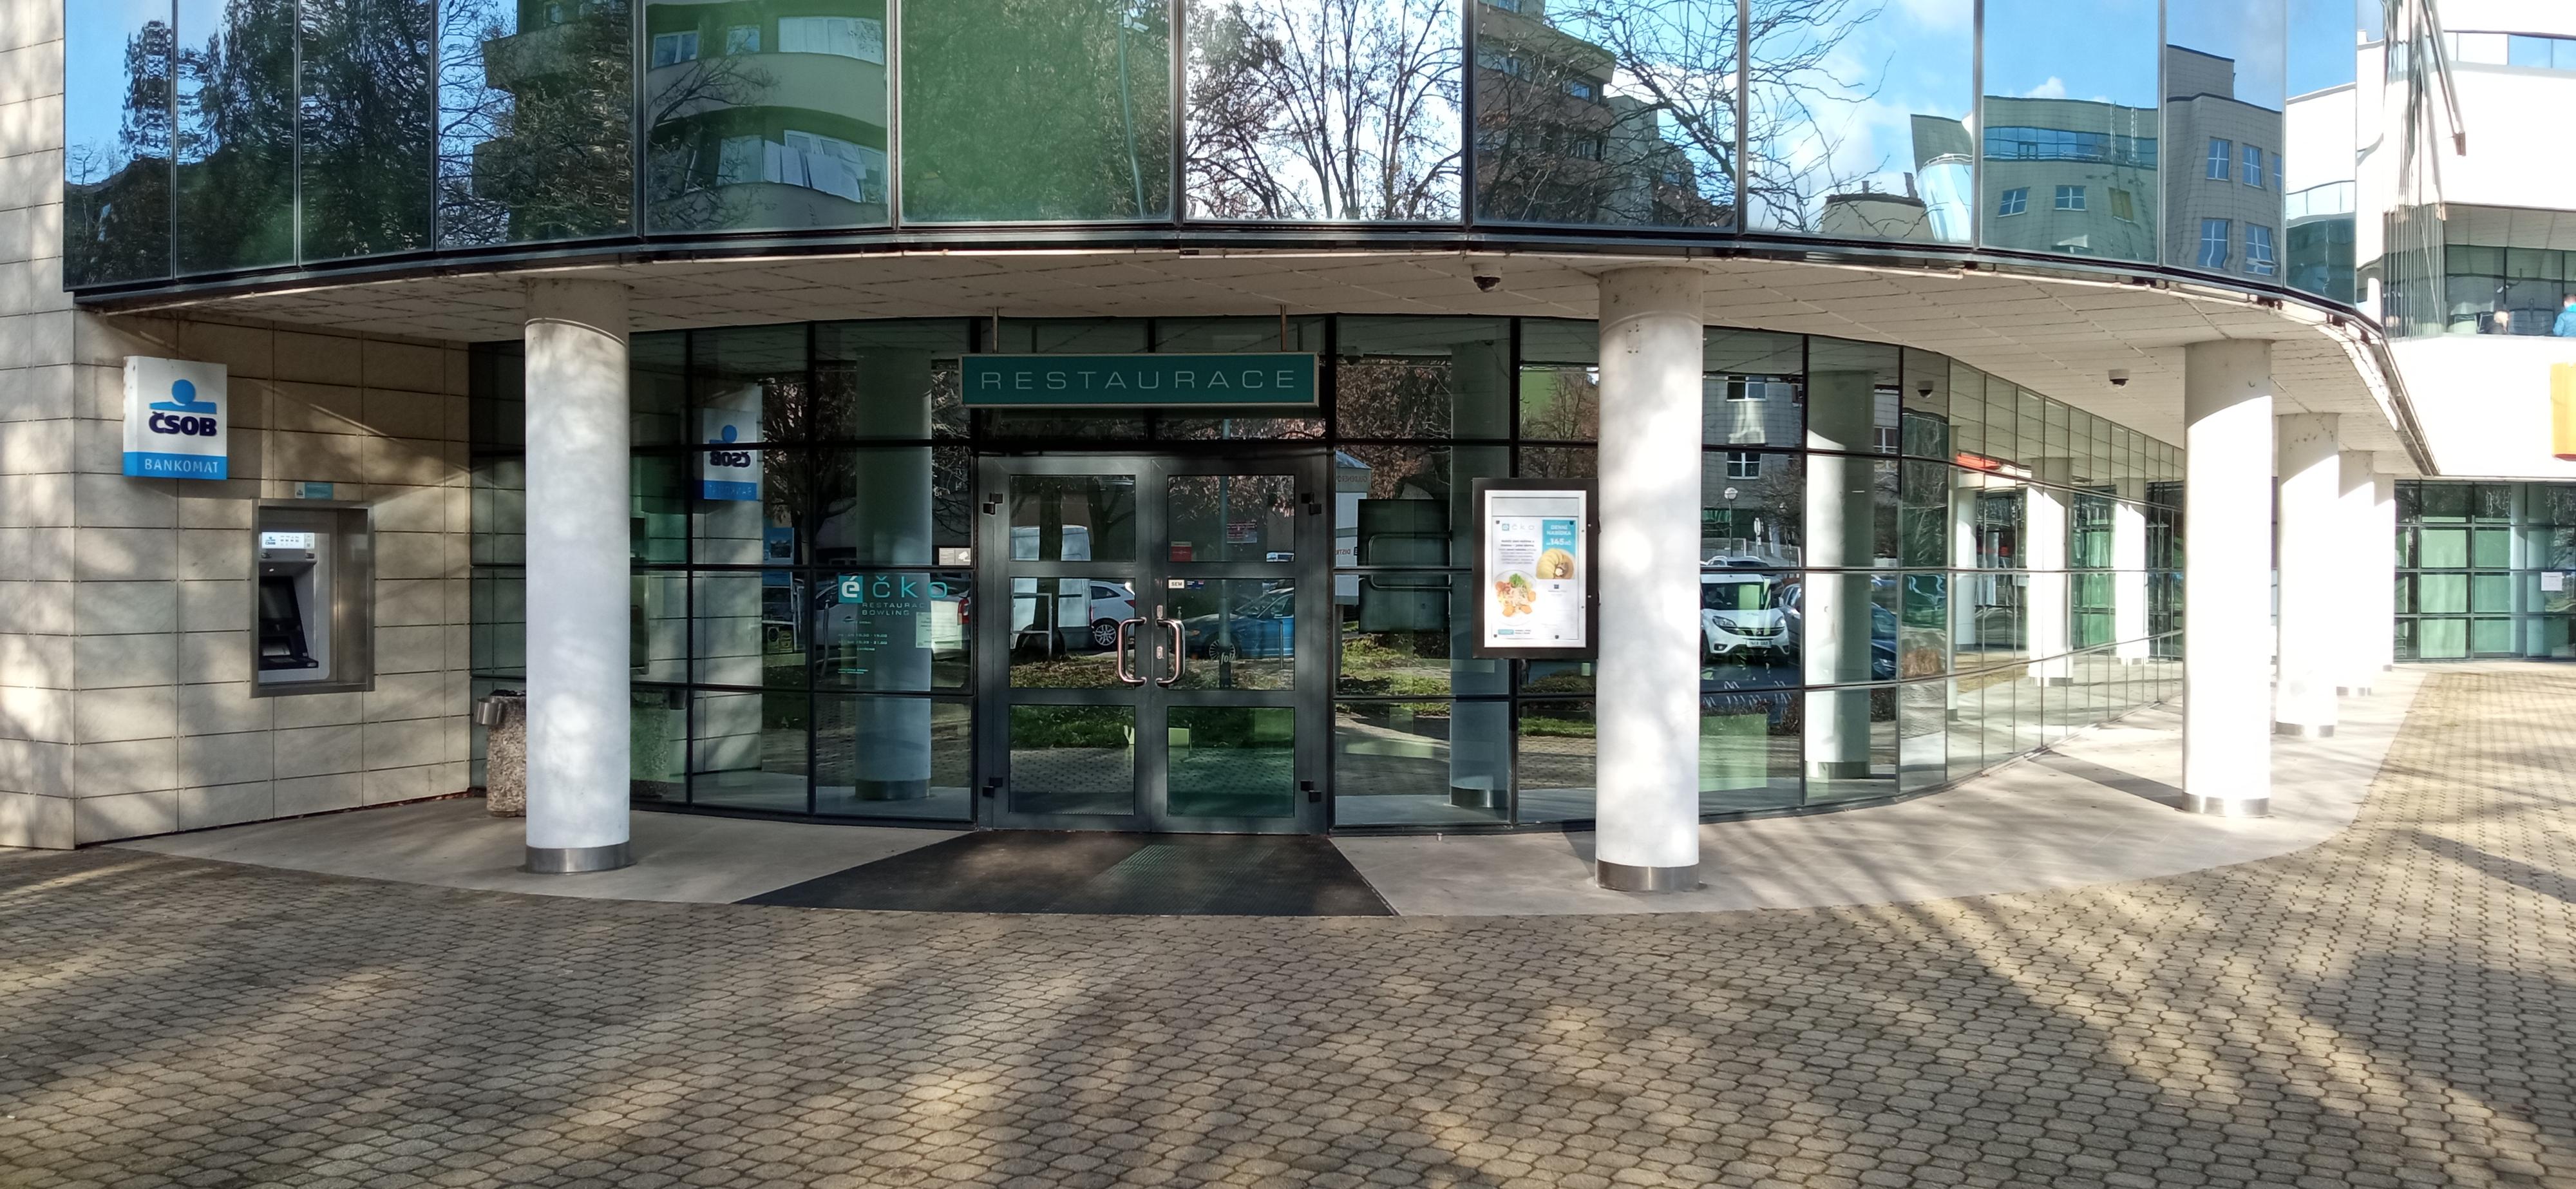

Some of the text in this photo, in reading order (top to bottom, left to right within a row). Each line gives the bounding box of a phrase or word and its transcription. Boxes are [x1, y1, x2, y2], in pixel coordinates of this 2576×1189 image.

[981, 370, 1294, 390] RESTAURACE
[149, 411, 217, 437] ČSOB
[145, 459, 218, 473] BANKOMAT
[842, 576, 948, 598] éčko
